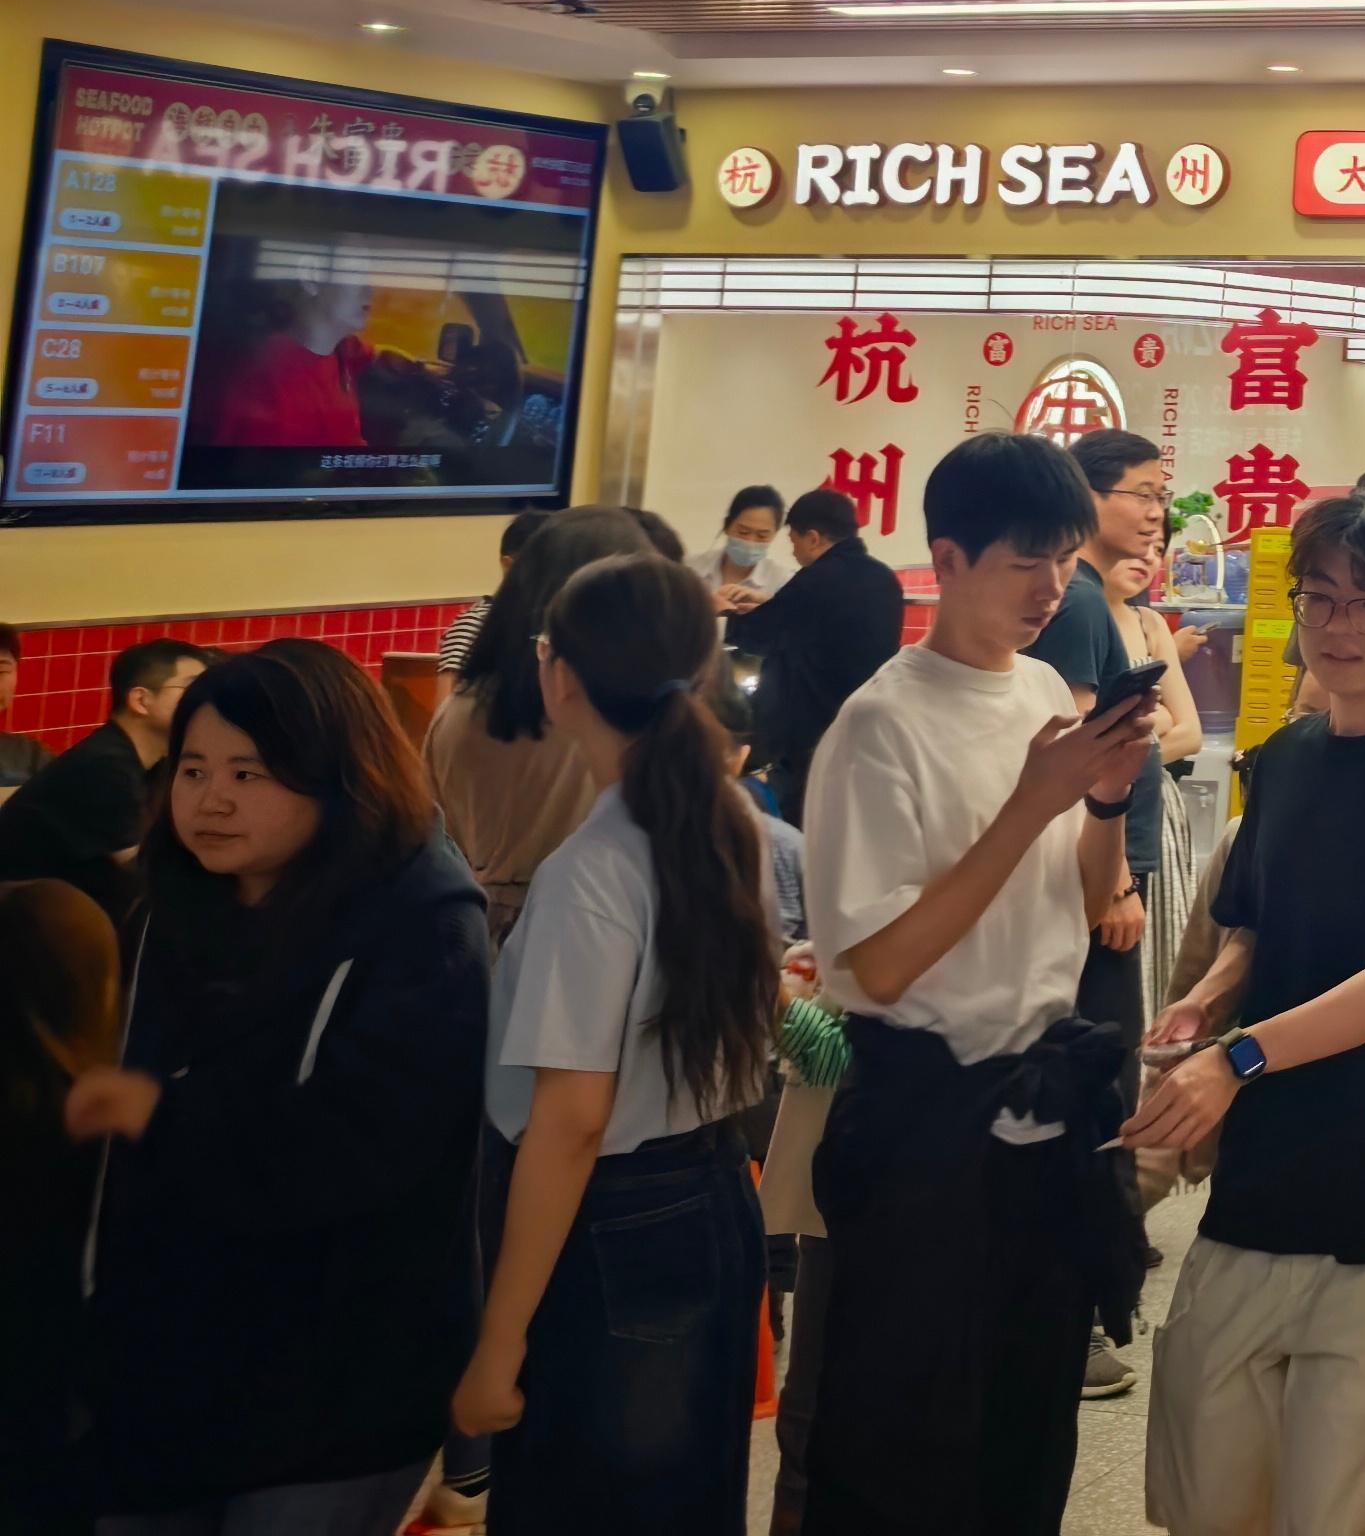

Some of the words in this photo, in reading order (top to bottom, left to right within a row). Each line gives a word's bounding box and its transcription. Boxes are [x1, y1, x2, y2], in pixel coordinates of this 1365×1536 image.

[721, 153, 764, 196] 杭
[794, 142, 982, 207] RICH
[997, 142, 1150, 207] SEA
[1173, 152, 1210, 194] 州
[1033, 315, 1075, 331] RICH
[1083, 315, 1118, 331] SEA
[42, 337, 82, 359] C28
[819, 312, 920, 537] 杭州
[964, 385, 981, 433] RICH
[1162, 388, 1179, 437] RICH
[1210, 307, 1320, 545] 富贵
